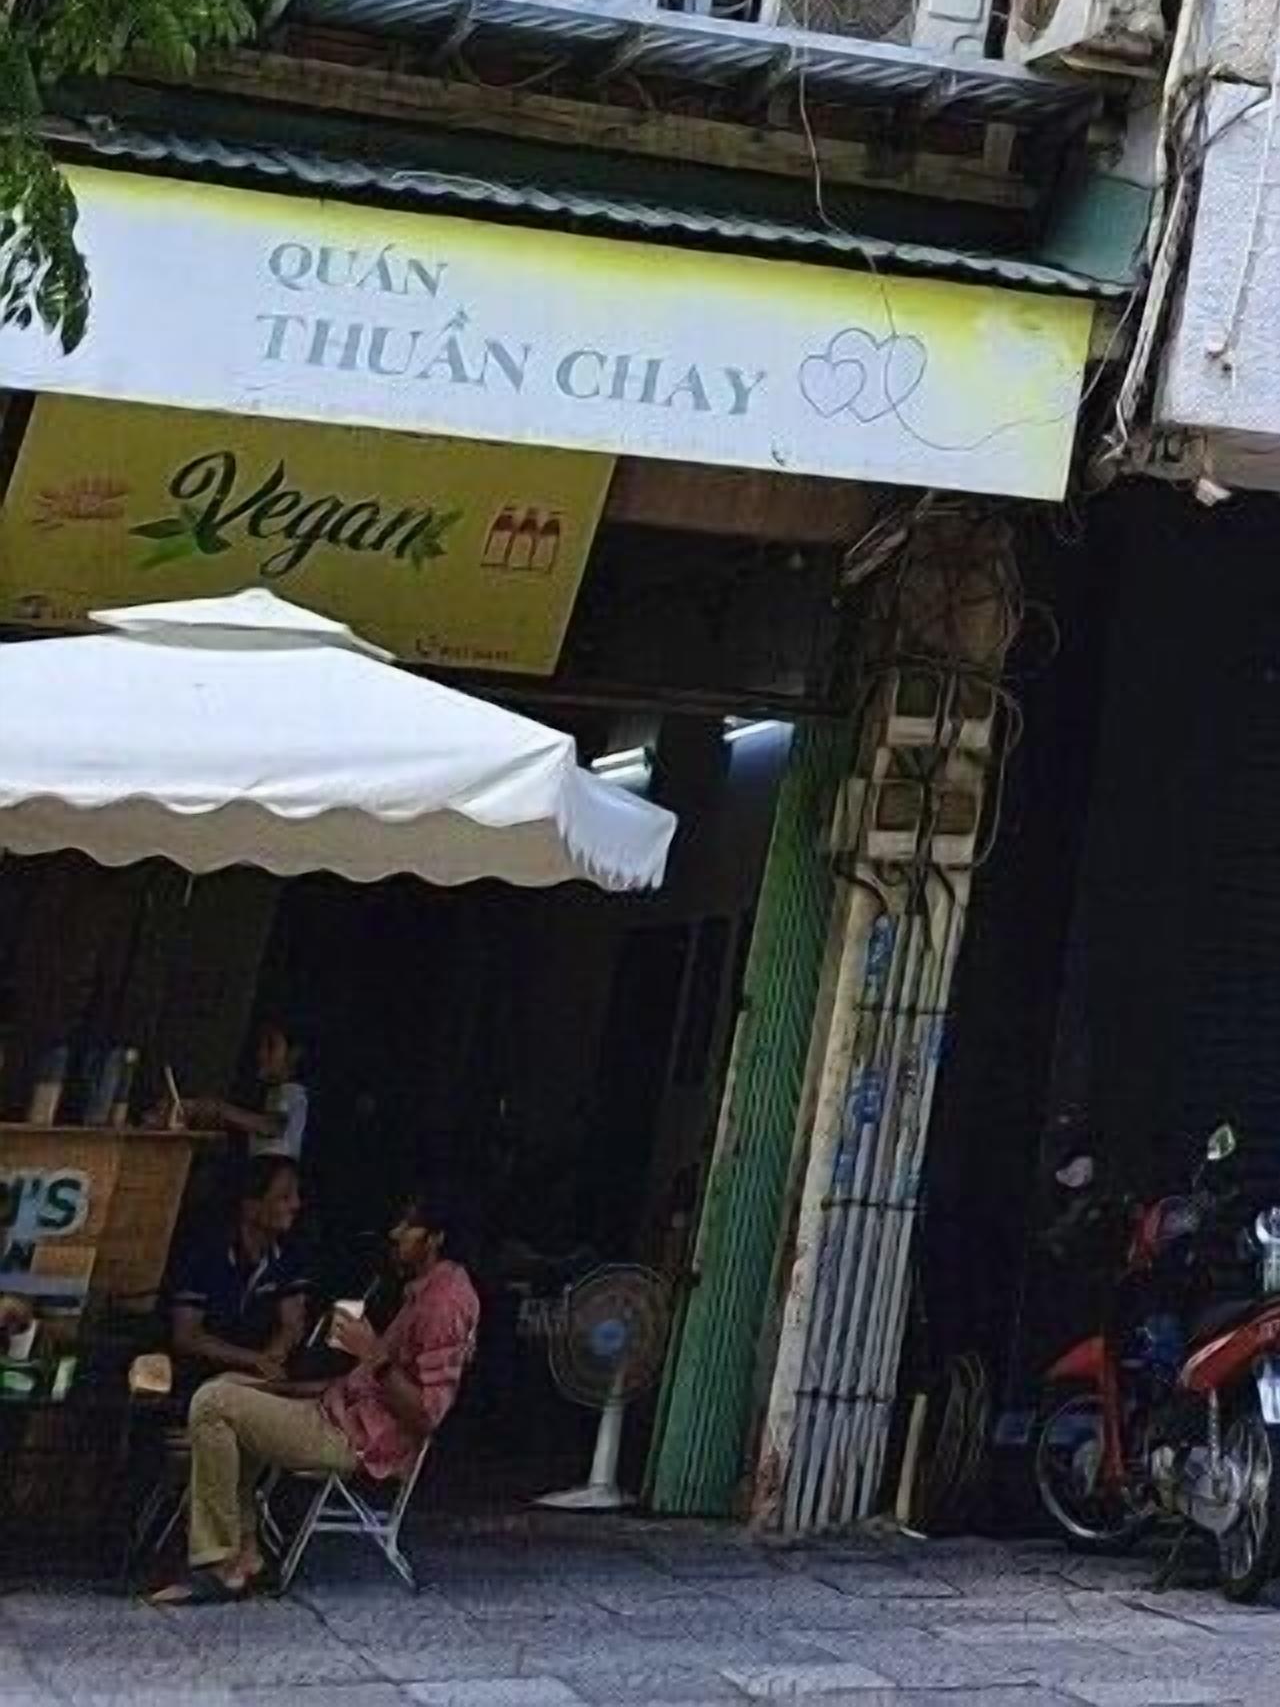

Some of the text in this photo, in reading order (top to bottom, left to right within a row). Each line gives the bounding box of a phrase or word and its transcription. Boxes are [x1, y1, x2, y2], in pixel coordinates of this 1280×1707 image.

[268, 243, 447, 298] QUÁN
[556, 350, 767, 414] CHAY
[169, 451, 434, 576] Vegan
